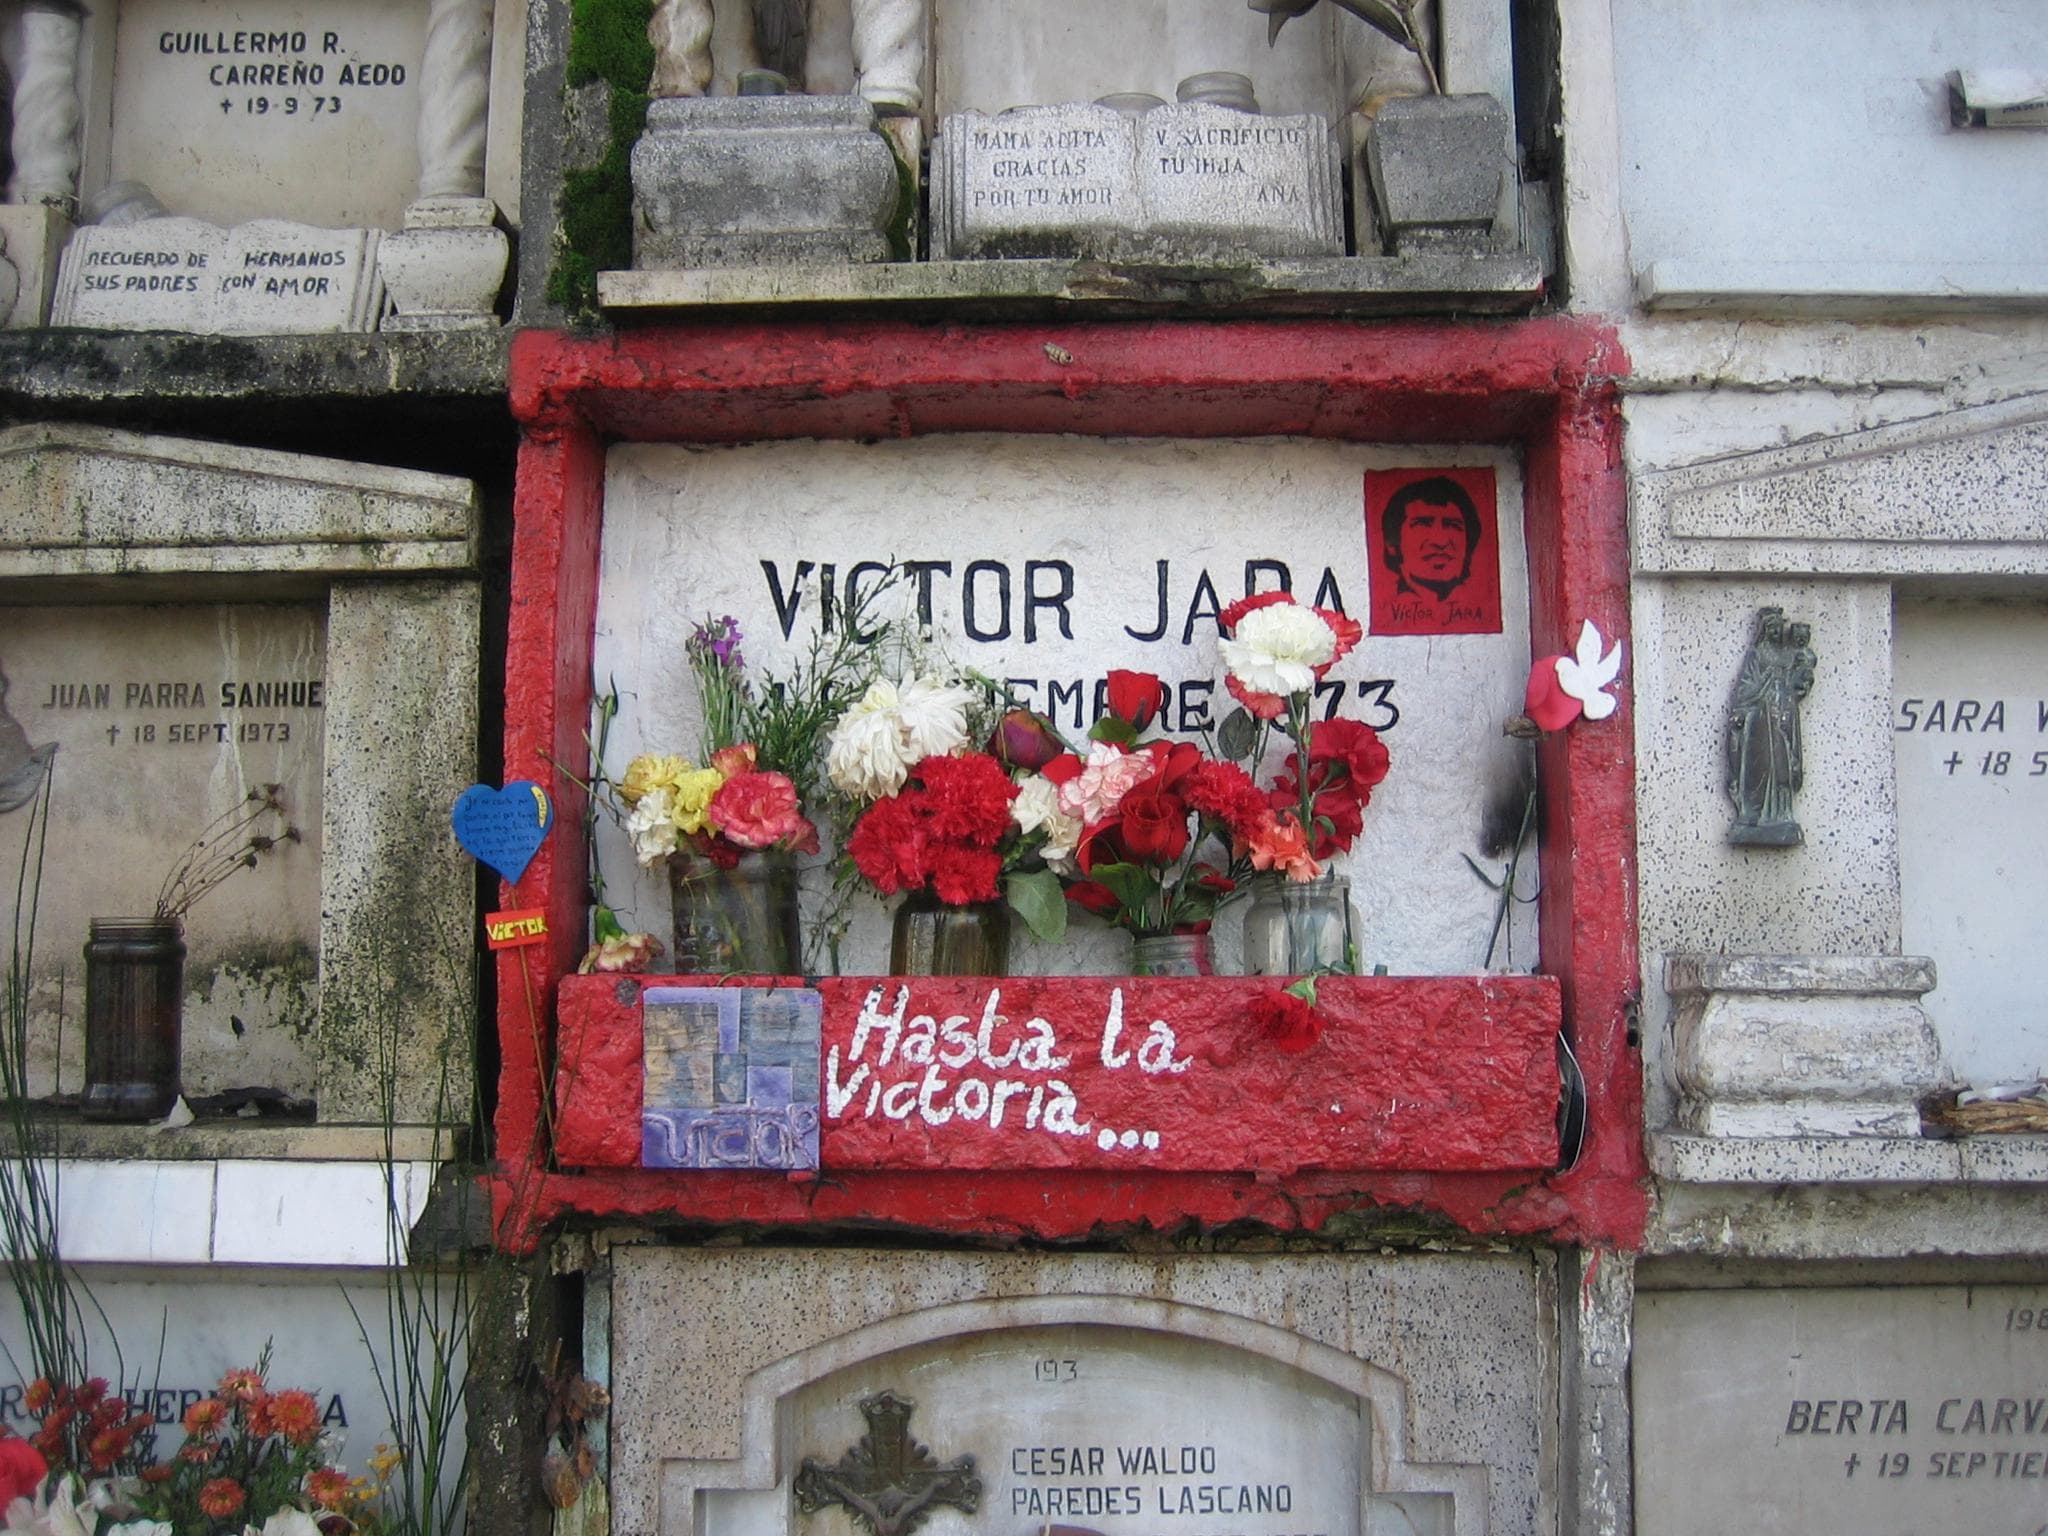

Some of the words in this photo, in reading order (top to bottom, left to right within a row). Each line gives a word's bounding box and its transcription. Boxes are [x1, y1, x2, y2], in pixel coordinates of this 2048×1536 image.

[159, 31, 307, 54] GUILLERMO
[323, 31, 346, 54] R.
[209, 60, 324, 86] CARREÑO
[338, 64, 406, 86] AEDO
[974, 131, 1031, 149] MAMA
[993, 159, 1086, 178] GRACIAS
[1160, 158, 1185, 174] TU
[974, 188, 1015, 208] POR
[1024, 188, 1049, 206] TU
[1057, 187, 1112, 206] AMOR
[1257, 184, 1299, 203] ANA
[86, 251, 180, 268] RECUERDO
[187, 252, 209, 268] DE
[244, 250, 346, 268] HERMANOS
[84, 274, 121, 291] SUS
[126, 275, 199, 293] PADRES
[222, 273, 257, 293] CON
[265, 276, 330, 297] AMOR
[759, 559, 1074, 645] VICTOR
[42, 683, 110, 710] JUAN
[125, 683, 206, 710] PARRA
[1895, 699, 2004, 732] SARA
[135, 725, 155, 743] 18
[240, 723, 290, 743] 1973
[1981, 751, 2012, 776] 18
[849, 984, 1072, 1072] Hasta
[1785, 1399, 1908, 1435] BERTA
[1011, 1446, 1105, 1476] CESAR
[1117, 1446, 1217, 1476] WALDO
[1877, 1452, 1910, 1479] 19
[1926, 1452, 2048, 1479] SEPTIE
[1011, 1486, 1142, 1516] PAREDES
[1158, 1484, 1292, 1515] LASCANO
